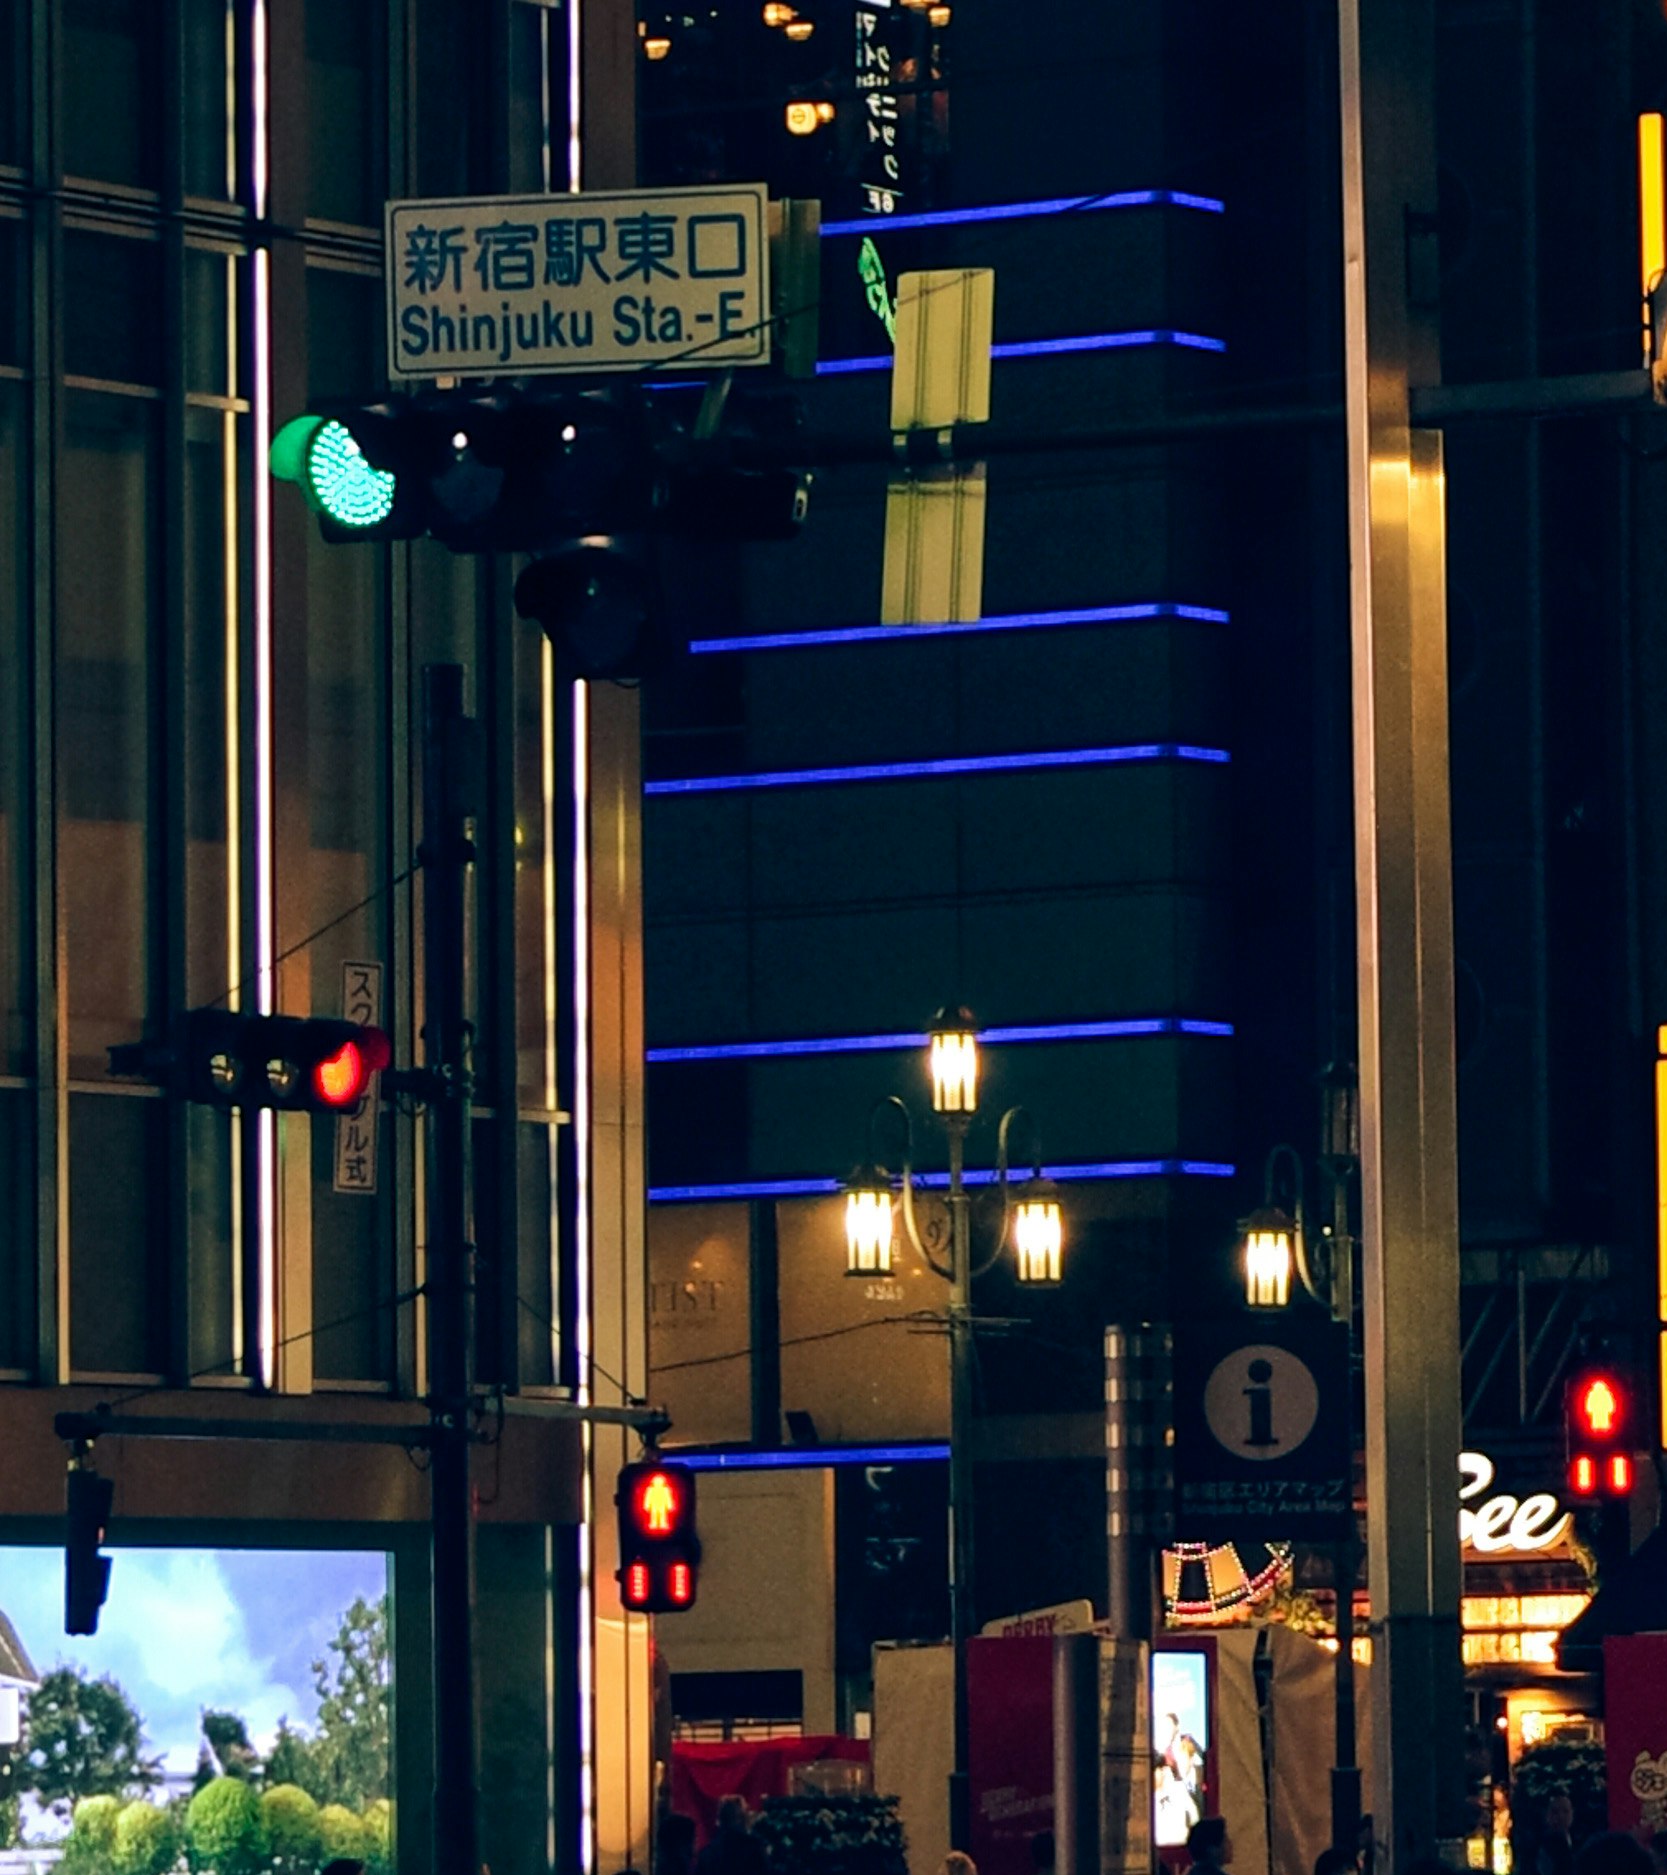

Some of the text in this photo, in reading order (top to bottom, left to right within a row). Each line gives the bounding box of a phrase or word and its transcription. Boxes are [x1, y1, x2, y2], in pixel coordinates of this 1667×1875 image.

[404, 212, 747, 296] 新宿駅東口
[401, 301, 594, 362] Shinjuku
[346, 971, 373, 1183] スクブル式
[1278, 1500, 1312, 1513] Area
